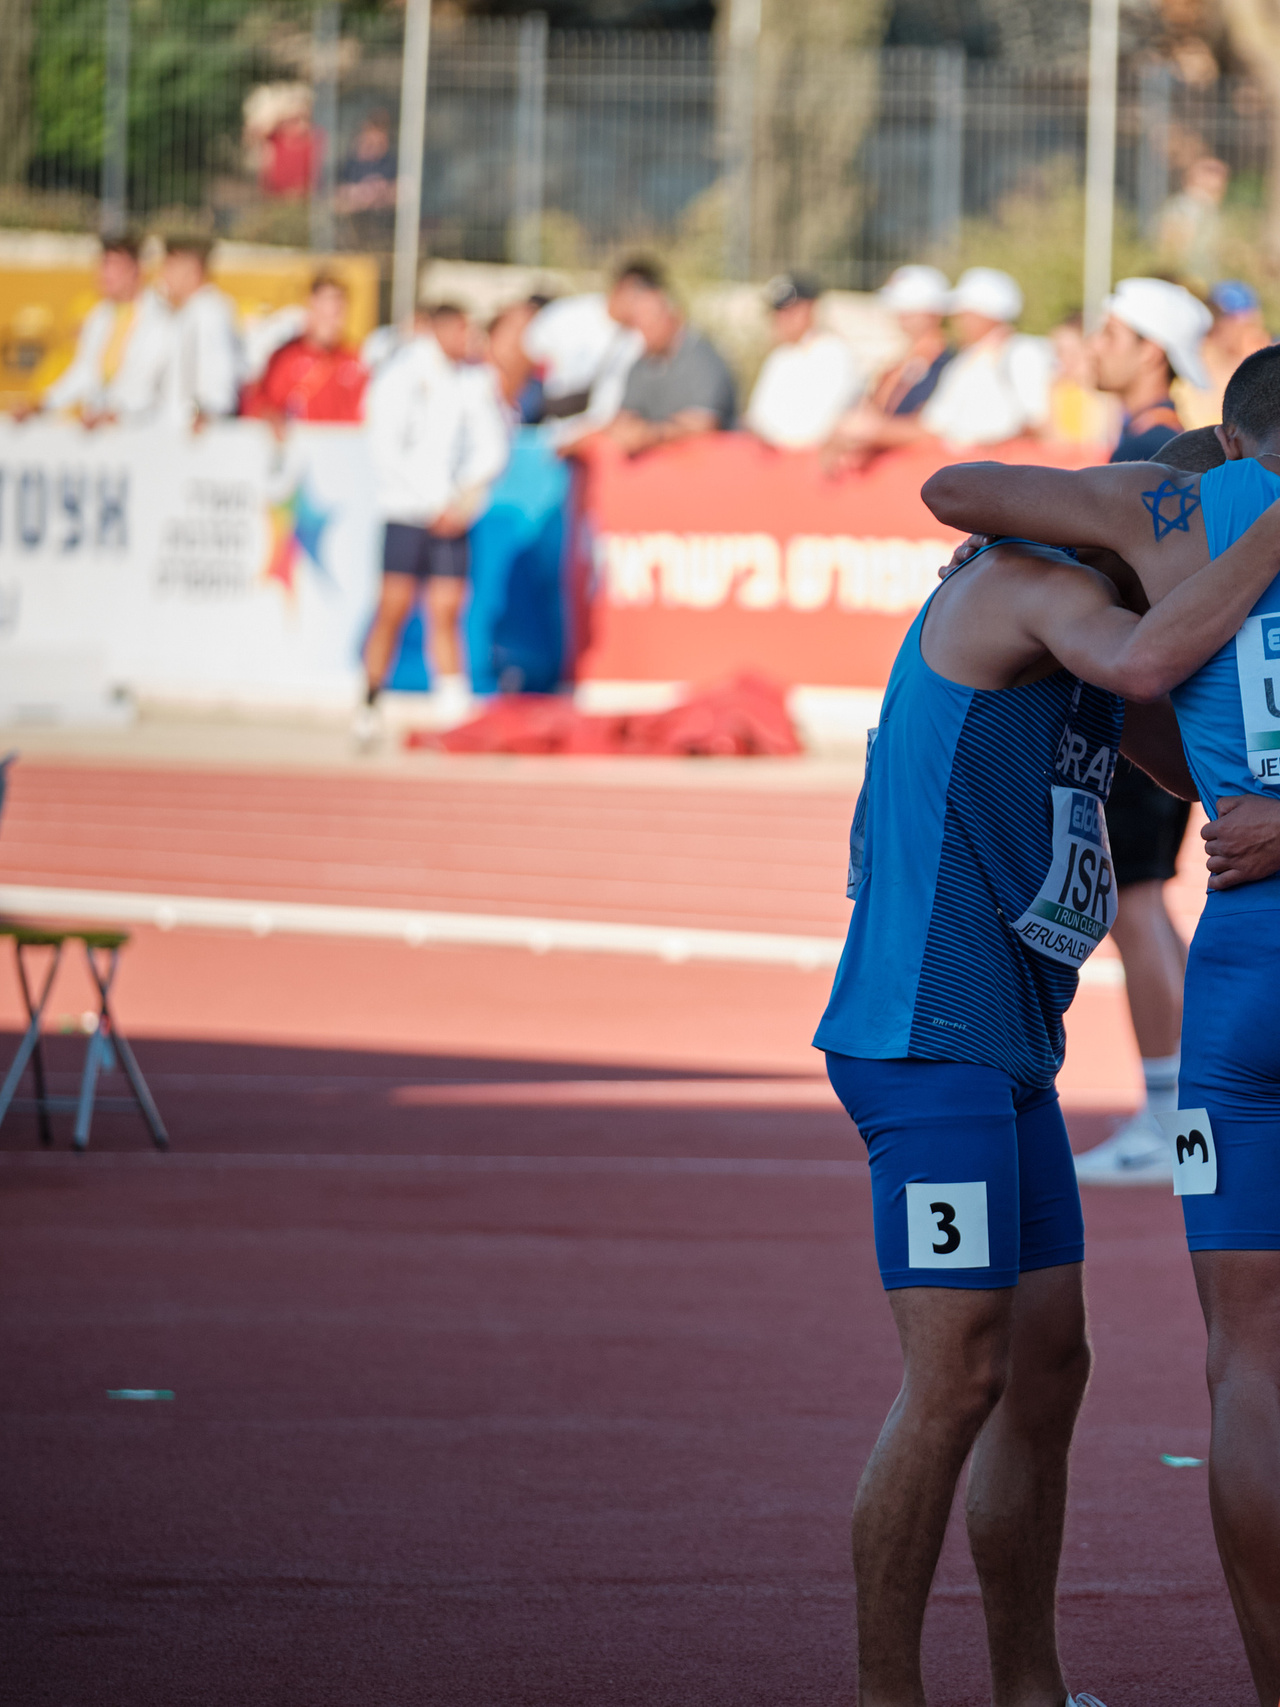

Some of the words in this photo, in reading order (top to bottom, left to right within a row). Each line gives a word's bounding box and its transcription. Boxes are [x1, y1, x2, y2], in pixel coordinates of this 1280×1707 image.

[1057, 842, 1112, 925] ISR
[1060, 909, 1080, 929] RUN
[932, 1018, 968, 1031] DRI-FIT
[1176, 1129, 1209, 1165] 3
[929, 1201, 961, 1255] 3
